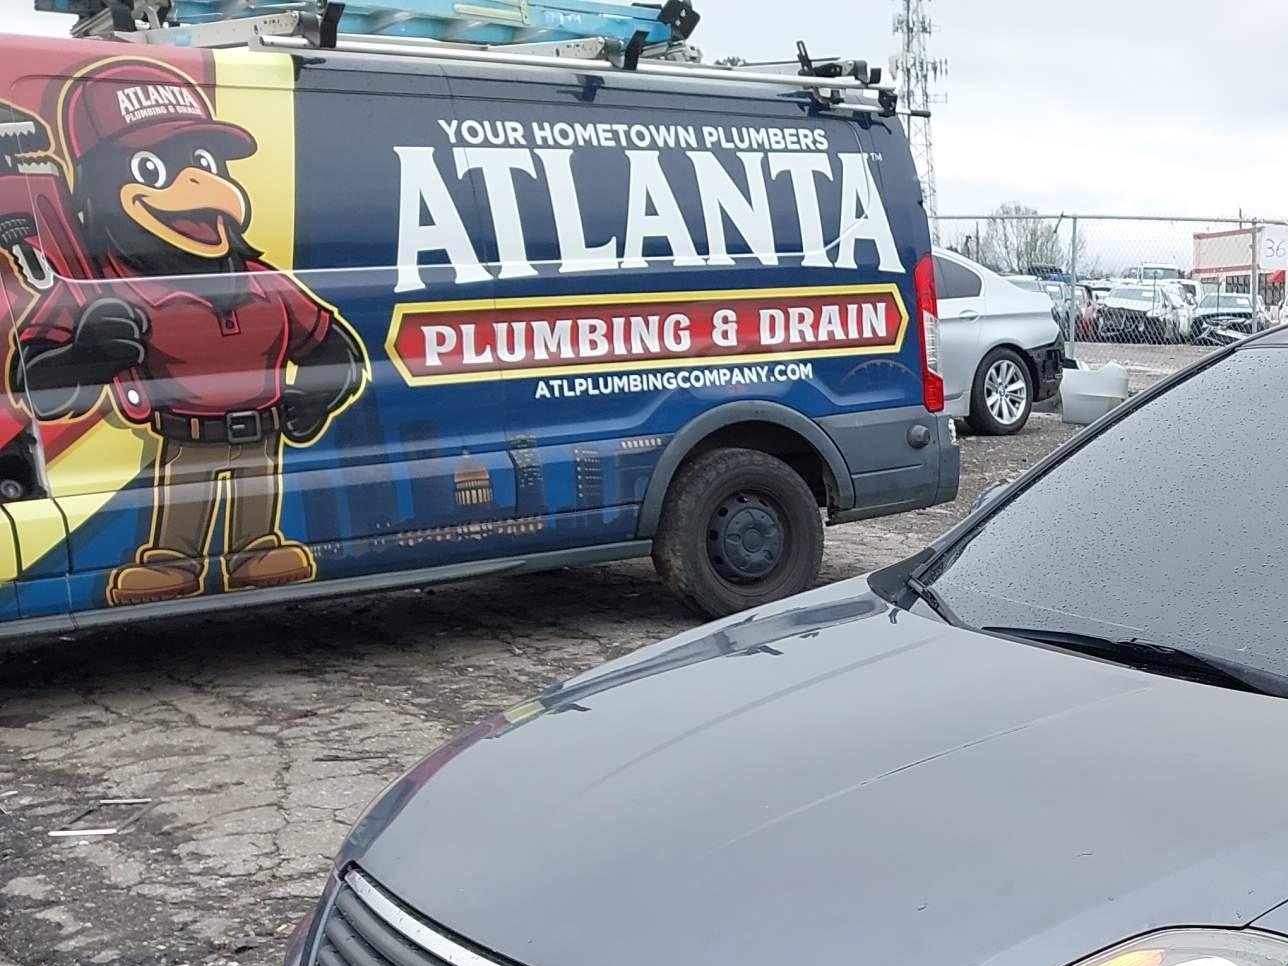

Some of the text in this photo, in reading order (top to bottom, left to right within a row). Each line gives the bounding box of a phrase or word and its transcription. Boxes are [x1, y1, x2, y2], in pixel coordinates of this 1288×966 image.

[117, 85, 200, 116] ATLANTA
[124, 106, 167, 124] PLUMBING
[438, 119, 829, 151] YOUR HOMETOWN PLUMBERS
[393, 146, 906, 294] ATLANTA
[1265, 238, 1287, 257] 36
[420, 302, 887, 367] PLUMBING & DRAIN
[535, 362, 814, 399] ATLPLUMBINGCOMPANY.COM
